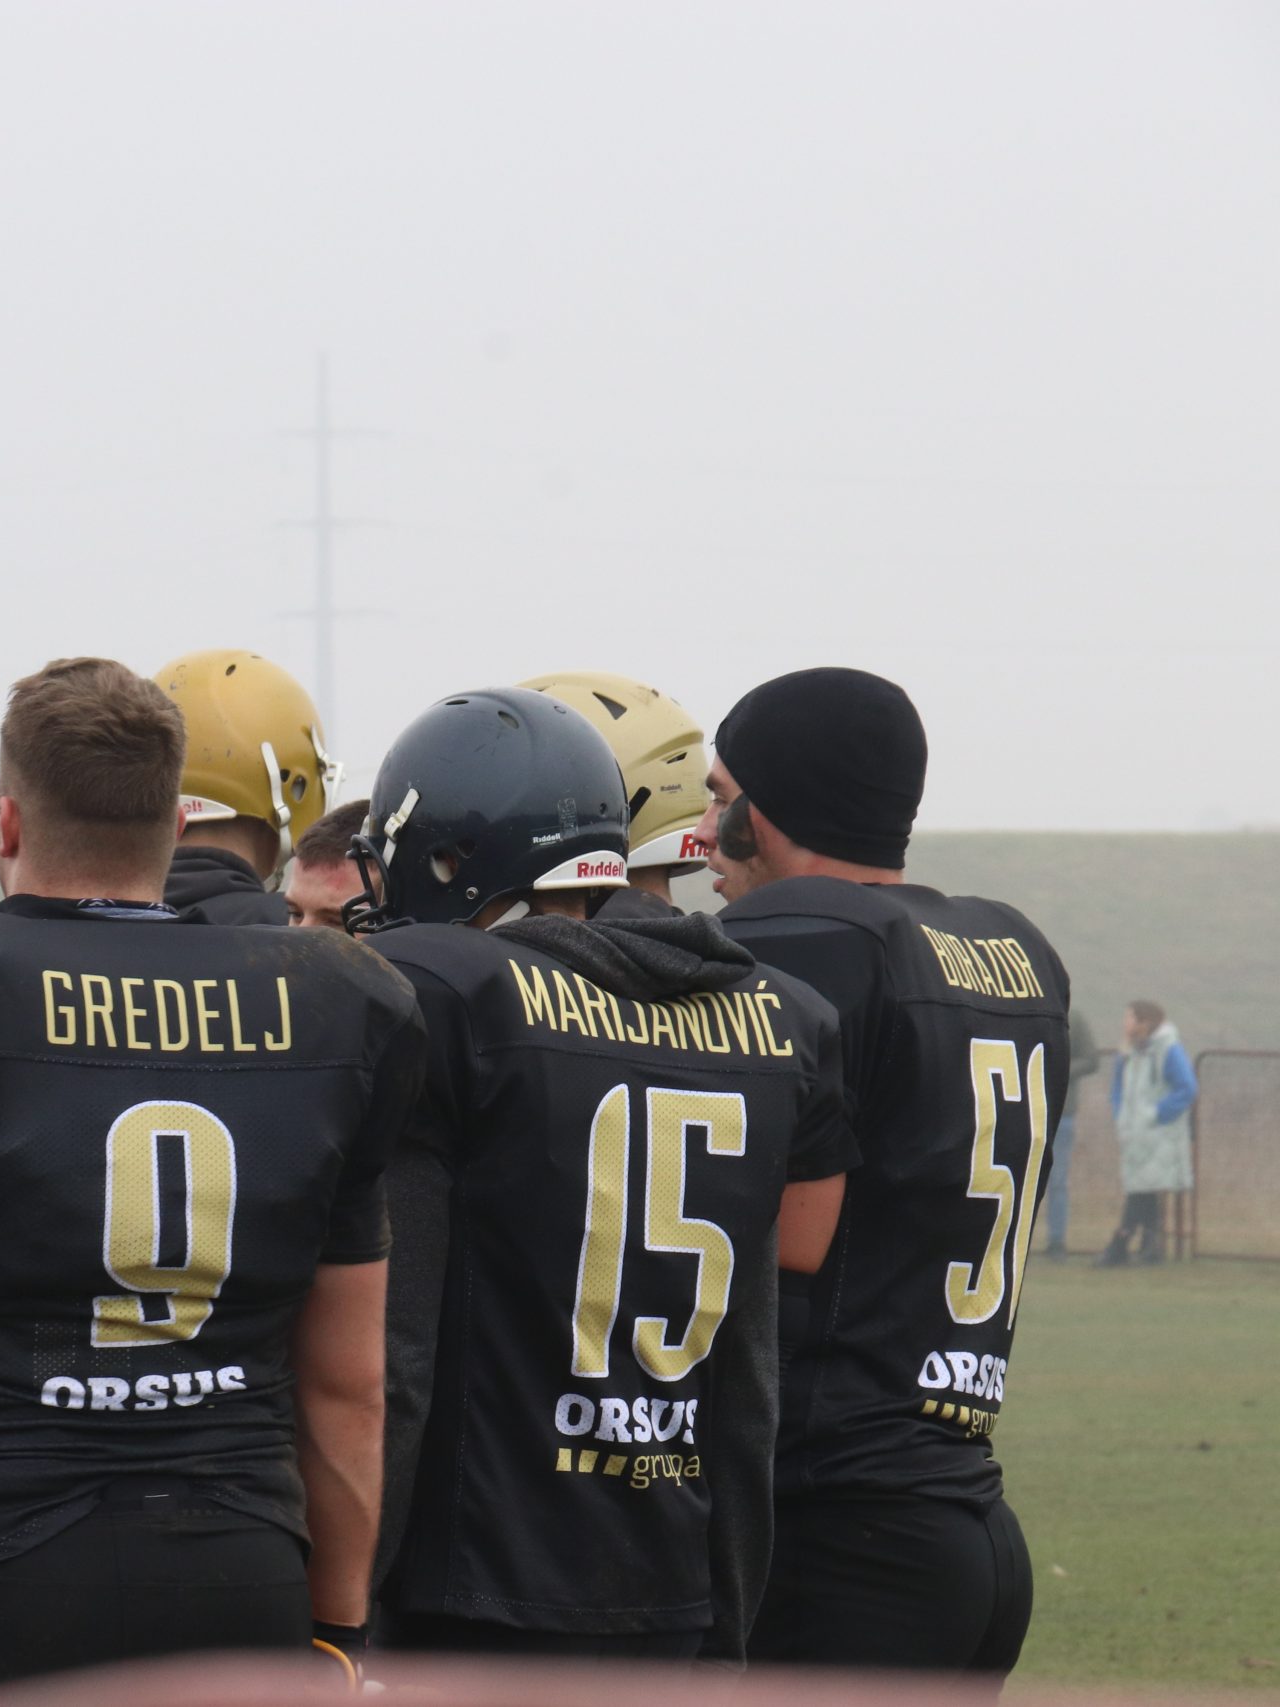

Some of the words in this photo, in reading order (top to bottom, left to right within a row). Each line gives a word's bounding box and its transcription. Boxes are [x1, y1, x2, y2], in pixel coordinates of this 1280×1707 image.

[532, 832, 561, 844] Riddell
[577, 862, 624, 878] Riddell
[920, 924, 1044, 998] BURAZOR
[42, 969, 292, 1051] GREDELJ
[508, 958, 794, 1057] MARIJANOVIĆ
[945, 1037, 1048, 1331] 51
[90, 1100, 237, 1348] 9
[570, 1083, 747, 1383] 15
[40, 1365, 248, 1412] ORSUS
[917, 1351, 1008, 1403] ORSUS
[554, 1393, 699, 1445] ORSUS
[629, 1454, 701, 1489] grupa
